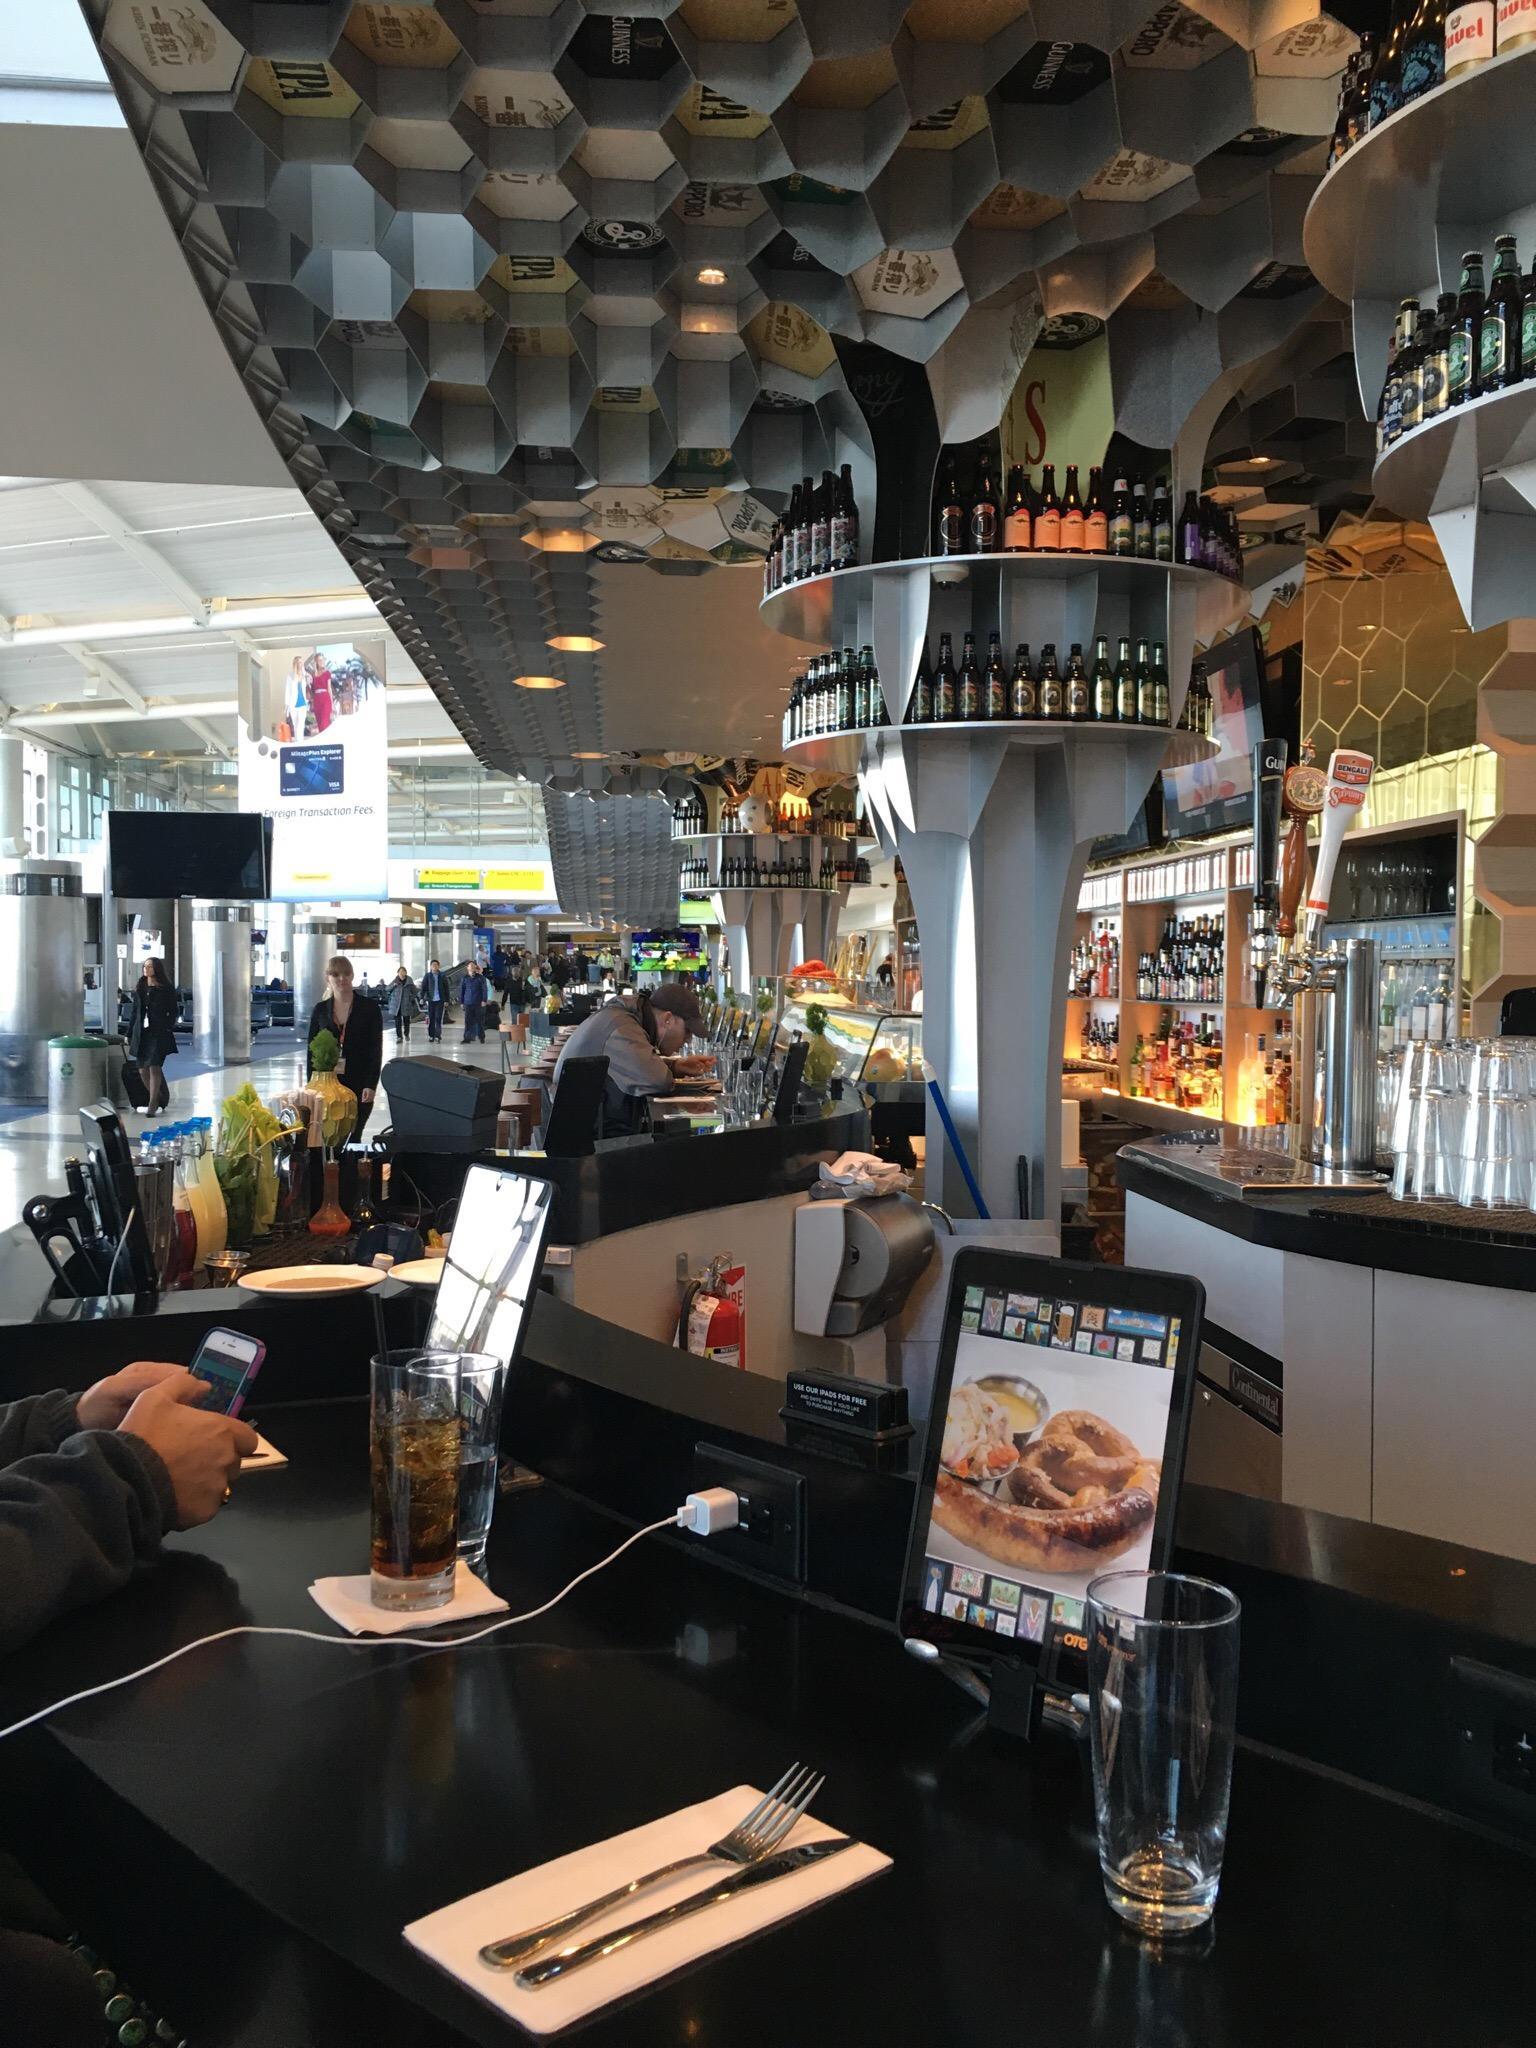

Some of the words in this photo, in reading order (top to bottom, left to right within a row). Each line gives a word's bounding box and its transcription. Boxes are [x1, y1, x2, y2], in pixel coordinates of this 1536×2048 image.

[610, 15, 632, 66] GUINNESS
[1445, 18, 1484, 49] uvel
[1032, 41, 1074, 91] GUINNESS
[270, 60, 334, 100] IPA
[1337, 764, 1368, 775] BENGALI
[328, 781, 341, 789] VISA
[264, 808, 297, 819] Foreign
[299, 806, 352, 818] Transaction
[353, 805, 377, 816] Fees.
[793, 1383, 804, 1392] USE
[805, 1387, 818, 1396] OUR
[837, 1393, 851, 1402] FOR
[851, 1396, 868, 1407] FREE
[812, 1402, 833, 1412] PURCHASE
[833, 1406, 855, 1417] ANYTHING
[850, 1404, 860, 1413] LIKE
